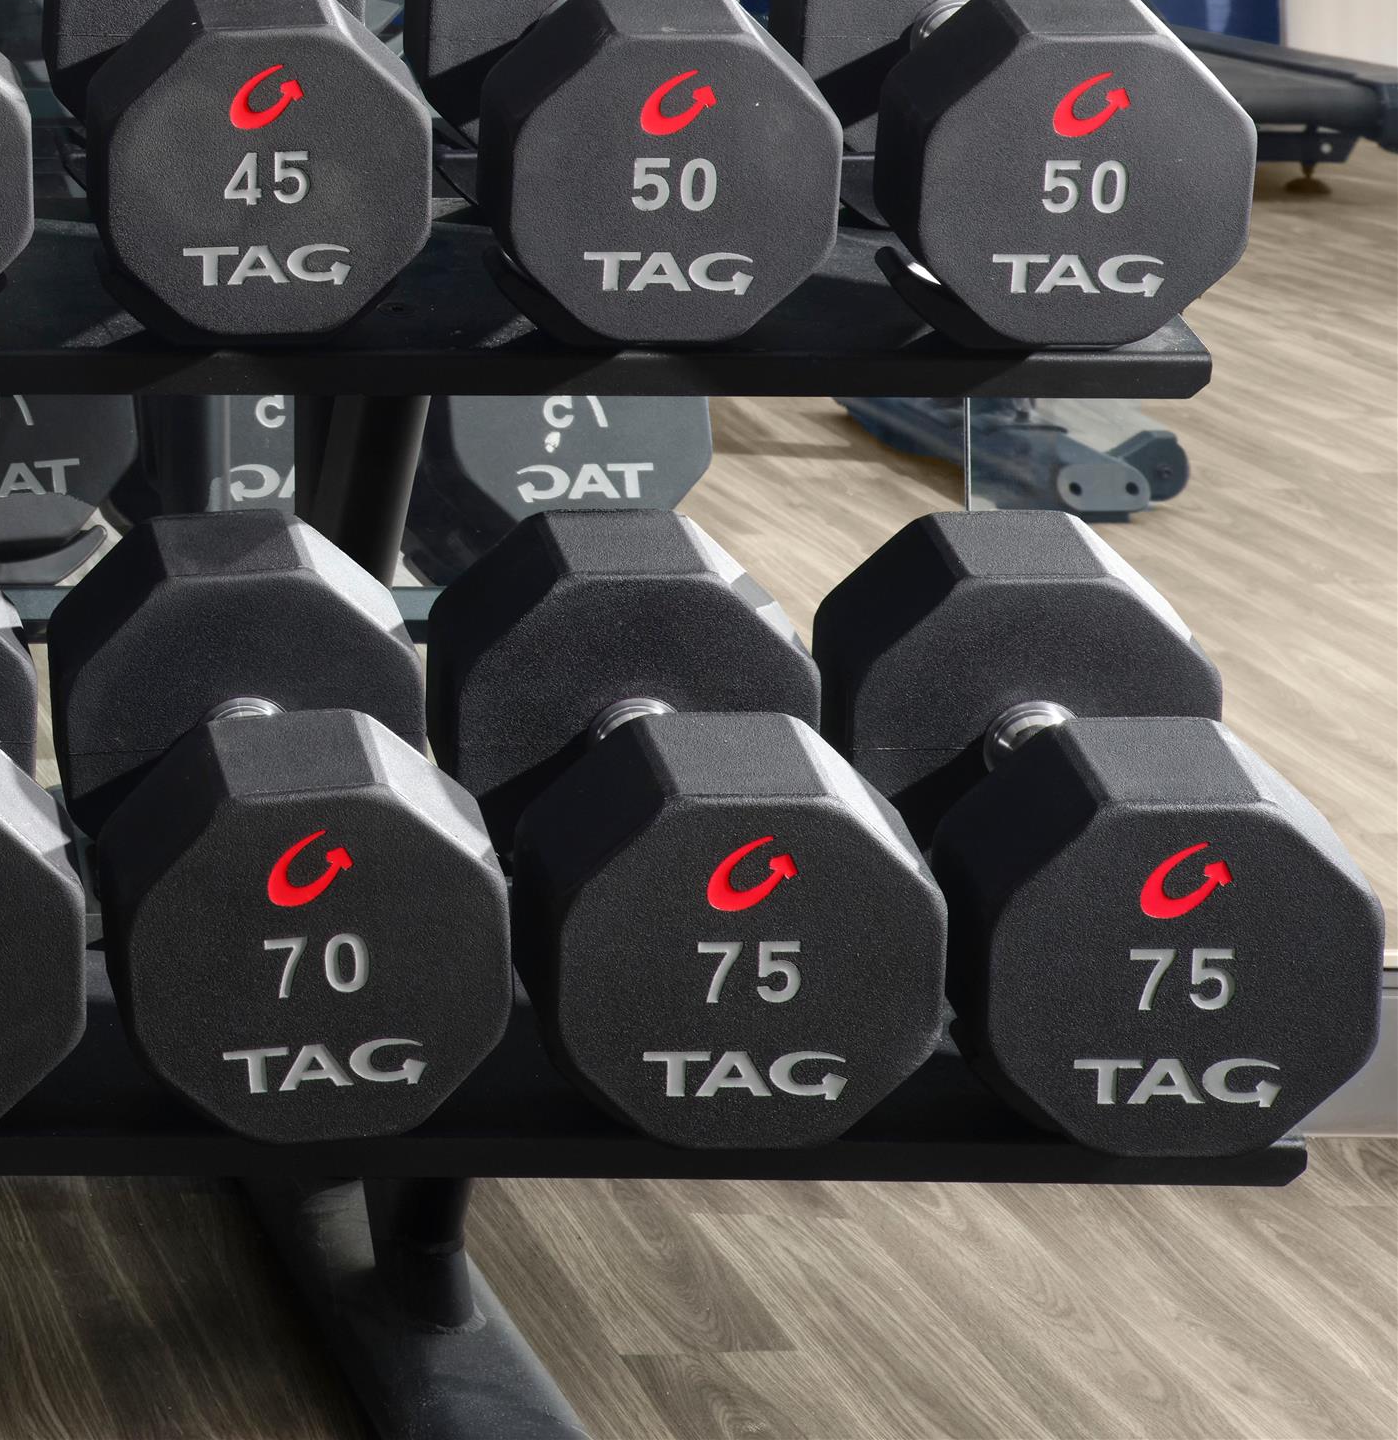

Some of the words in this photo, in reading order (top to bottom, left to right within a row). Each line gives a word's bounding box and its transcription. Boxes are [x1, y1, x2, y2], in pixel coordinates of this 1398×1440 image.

[222, 150, 309, 207] 45
[630, 156, 719, 213] 50
[1041, 159, 1127, 215] 50
[181, 242, 351, 288] TAG
[582, 250, 754, 297] TAG
[990, 252, 1165, 299] TAG
[262, 932, 368, 1000] 70
[695, 939, 801, 1005] 75
[1128, 947, 1235, 1012] 75
[221, 1037, 426, 1095] TAG
[641, 1049, 848, 1102] TAG
[1072, 1056, 1281, 1110] TAG
